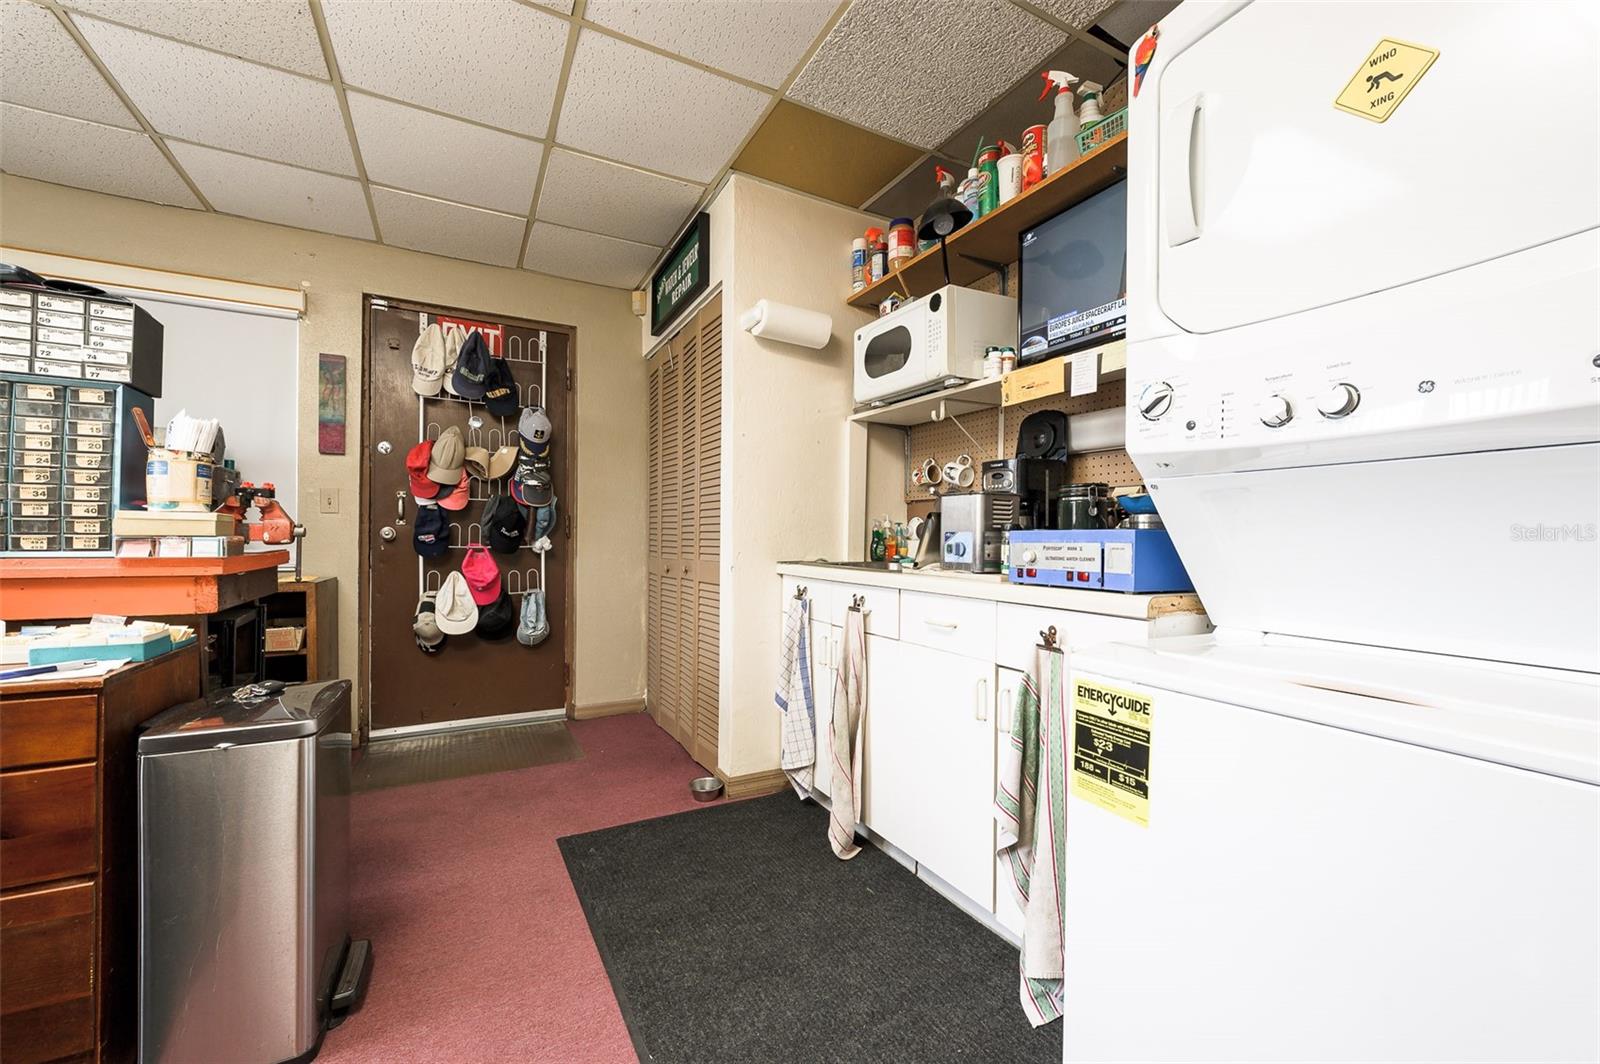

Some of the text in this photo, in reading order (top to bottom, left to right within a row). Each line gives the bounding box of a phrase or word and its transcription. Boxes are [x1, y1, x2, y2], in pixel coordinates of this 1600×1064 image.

[1369, 48, 1397, 68] WINO
[1370, 92, 1395, 109] XING
[671, 273, 692, 305] REPAIR
[40, 300, 53, 308] 56
[1049, 318, 1071, 333] EUROPE'S
[1085, 302, 1118, 320] SPACECRAFT
[92, 340, 104, 348] 69
[39, 349, 52, 357] 72
[86, 353, 97, 361] 74
[89, 426, 102, 434] 15
[38, 440, 51, 448] 19
[87, 442, 102, 450] 20
[35, 457, 50, 465] 24
[86, 458, 101, 466] 25
[34, 473, 50, 481] 29
[85, 475, 99, 483] 30
[32, 489, 47, 498] 34
[86, 491, 100, 499] 35
[83, 507, 98, 515] 40
[1077, 685, 1151, 716] ENERGYGUIDE
[1093, 737, 1114, 752] $23
[1118, 773, 1137, 787] $15
